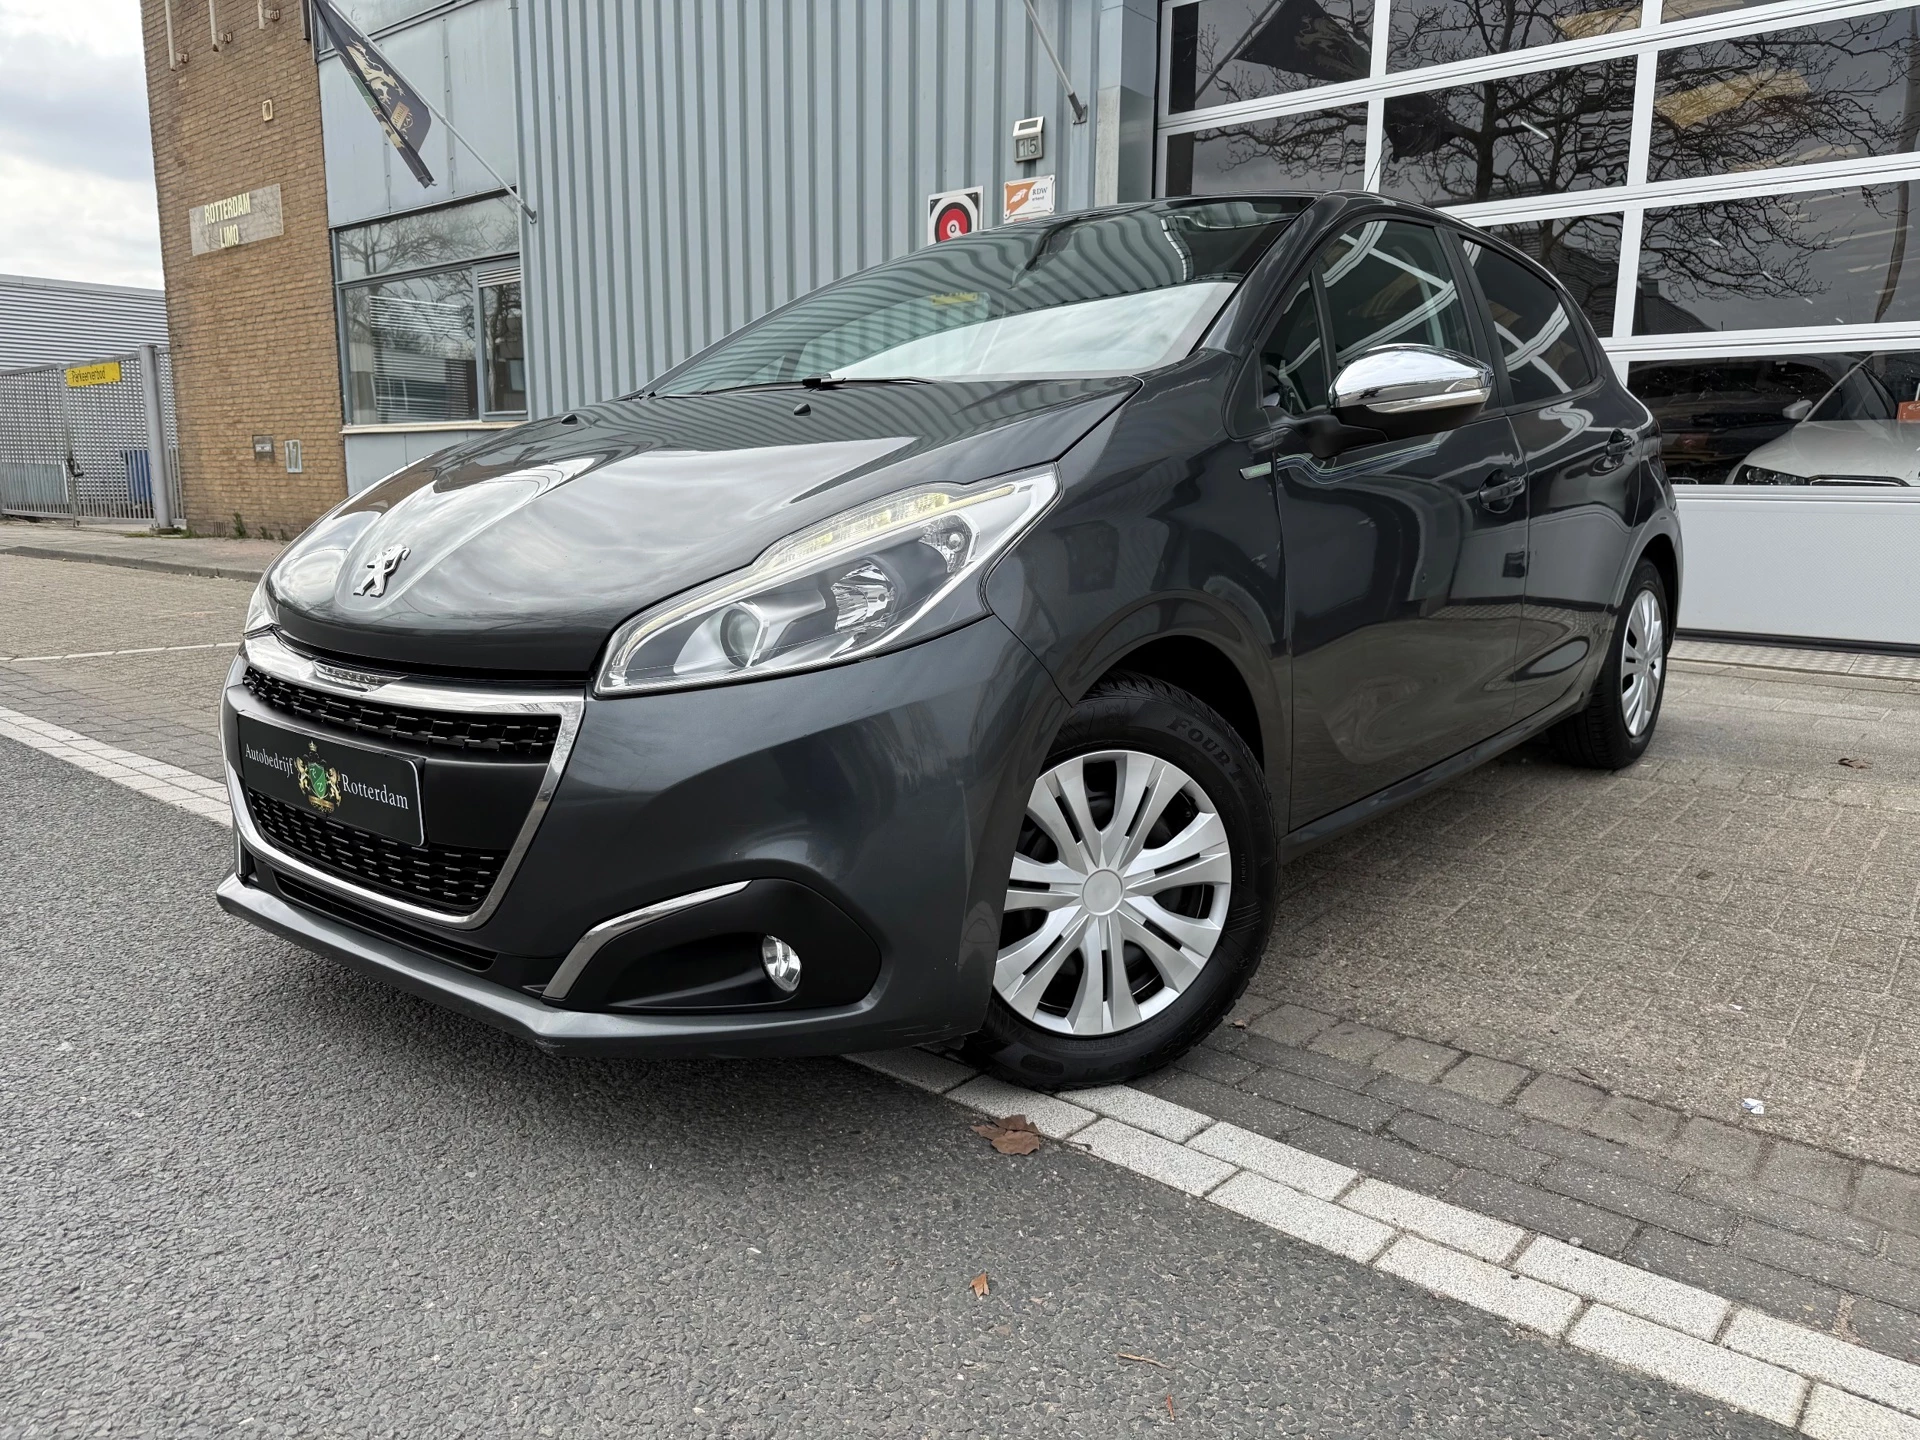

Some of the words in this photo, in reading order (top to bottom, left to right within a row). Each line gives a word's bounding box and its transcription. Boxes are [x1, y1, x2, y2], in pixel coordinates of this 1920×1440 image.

[1020, 139, 1037, 156] 15
[1032, 187, 1048, 195] RDW
[204, 192, 251, 225] ROTTERDAM
[219, 224, 239, 248] LIMO
[245, 743, 294, 778] Autobedrijf
[341, 773, 409, 810] Rotterdam
